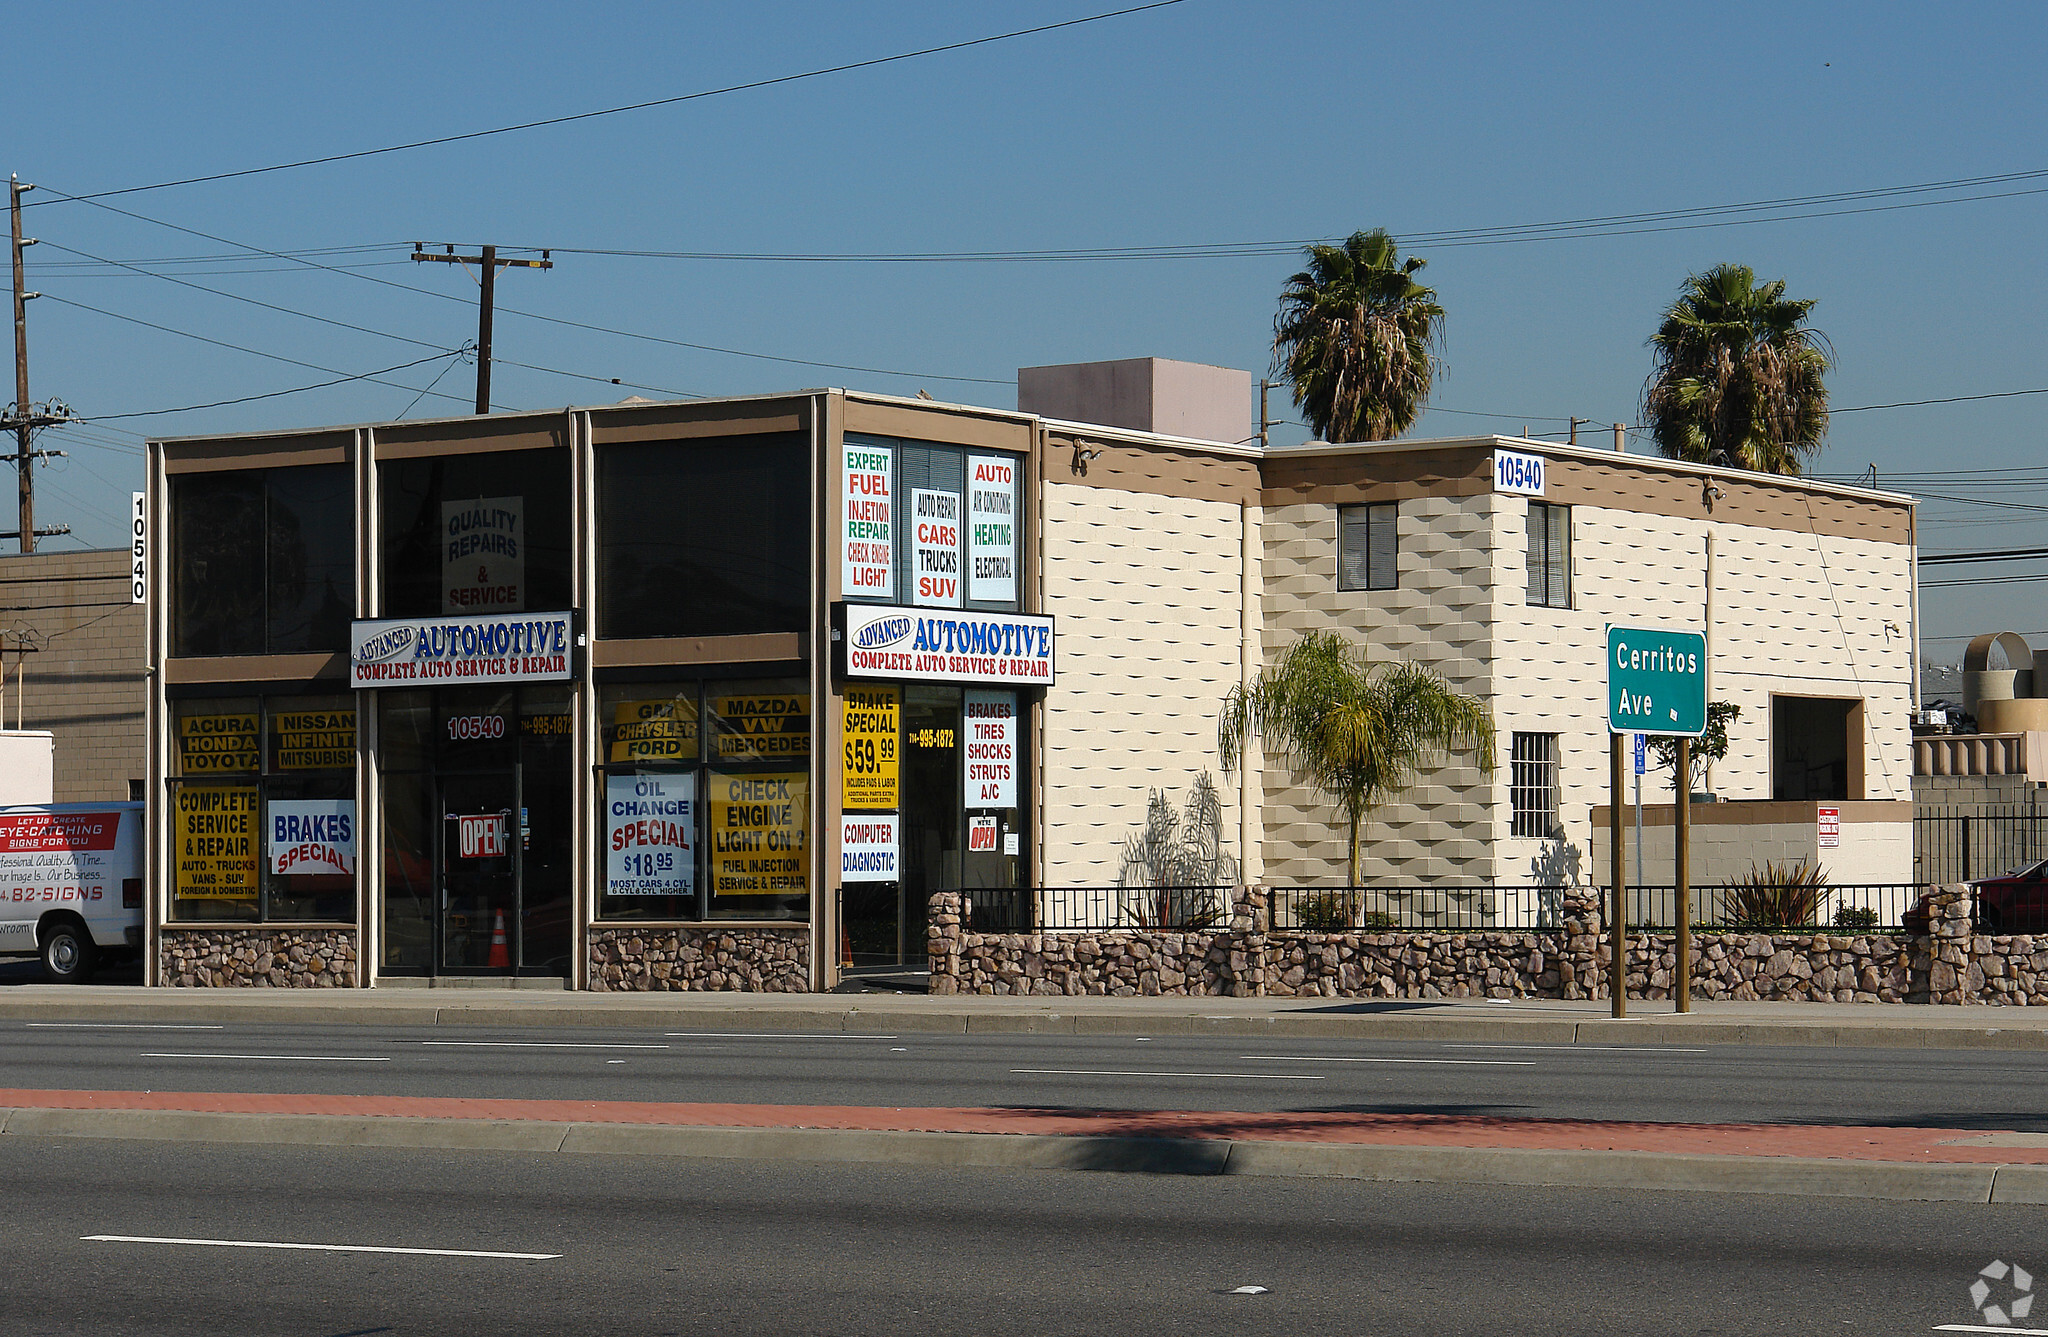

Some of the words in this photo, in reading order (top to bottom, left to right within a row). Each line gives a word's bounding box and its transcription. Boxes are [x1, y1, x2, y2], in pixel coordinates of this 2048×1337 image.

[847, 452, 888, 472] EXPERT
[975, 464, 1011, 484] AUTO
[1498, 456, 1541, 490] 10540
[849, 474, 889, 496] FUEL
[917, 493, 936, 518] AUTO
[937, 495, 957, 521] REPAIR
[973, 490, 983, 511] AIR
[848, 500, 889, 523] INJETION
[448, 509, 517, 536] QUALITY
[848, 521, 889, 540] REPAIR
[918, 523, 956, 547] CARS
[975, 523, 1011, 546] HEATING
[449, 533, 517, 562] REPAIRS
[848, 542, 869, 563] CHECK
[871, 544, 889, 565] ENGINE
[919, 549, 957, 573] TRUCKS
[975, 557, 1012, 579] ELECTRICAL
[477, 565, 488, 583] &
[853, 567, 887, 587] LIGHT
[450, 586, 517, 606] SERVICE
[919, 577, 956, 598] SUV
[360, 629, 412, 661] ADVANCED
[414, 620, 567, 658] AUTOMOTIVE
[858, 617, 911, 647] ADVANCED
[912, 617, 1050, 658] AUTOMOTIVE
[356, 661, 417, 680] COMPLETE
[420, 661, 452, 678] AUTO
[455, 658, 506, 677] SERVICE
[509, 656, 518, 674] &
[522, 655, 567, 674] REPAIR
[852, 650, 912, 671] COMPLETE
[915, 654, 946, 672] AUTO
[949, 656, 996, 675] SERVICE
[999, 659, 1007, 675] &
[1010, 659, 1049, 677] REPAIR
[1617, 642, 1697, 674] Cerritos
[728, 699, 801, 715] MAZDA
[849, 693, 893, 710] BRAKE
[969, 703, 1011, 719] BRAKES
[1618, 688, 1653, 716] Ave
[188, 718, 256, 734] ACURA
[284, 714, 356, 730] NISSAN
[448, 716, 504, 740] 10540
[617, 721, 698, 740] CHRYSLER
[741, 717, 785, 733] VW
[845, 713, 896, 733] SPECIAL
[974, 724, 1004, 740] TIRES
[187, 736, 257, 752] HONDA
[628, 740, 681, 757] FORD
[722, 736, 810, 753] MERCEDES
[968, 743, 1011, 760] SHOCKS
[184, 753, 259, 769] TOYOTA
[969, 764, 1011, 780] STRUTS
[635, 781, 666, 797] OIL
[729, 779, 790, 802] CHECK
[981, 783, 1000, 800] A/C
[180, 792, 257, 812] COMPLETE
[612, 801, 689, 816] CHANGE
[188, 814, 248, 834] SERVICE
[727, 804, 792, 827] ENGINE
[0, 824, 103, 838] EYE-CATCHING
[274, 815, 350, 842] BRAKES
[462, 819, 503, 855] OPEN
[612, 819, 690, 852] SPECIAL
[844, 824, 892, 844] COMPUTER
[971, 827, 995, 849] OPEN
[9, 839, 39, 848] SIGNS
[42, 838, 63, 846] FOR
[65, 837, 89, 845] YOU
[185, 840, 194, 856] &
[197, 837, 249, 856] REPAIR
[716, 831, 763, 853] LIGHT
[767, 830, 791, 852] ON
[797, 829, 805, 851] ?
[181, 861, 207, 871] AUTO
[216, 860, 255, 871] TRUCKS
[277, 843, 349, 874] SPECIAL
[723, 860, 746, 873] FUEL
[749, 859, 799, 873] INJECTION
[843, 852, 895, 872] DIAGNOSTIC
[10, 870, 32, 884] Image
[47, 869, 62, 881] Our
[191, 874, 217, 884] VANS
[226, 873, 244, 884] SUV
[610, 880, 636, 888] MOST
[639, 880, 662, 888] CARS
[665, 880, 670, 888] 4
[673, 880, 691, 888] CYL.
[719, 877, 757, 890] SERVICE
[762, 877, 768, 890] &
[770, 876, 806, 890] REPAIR
[13, 885, 103, 901] 82-SIGNS
[181, 886, 211, 895] FOREIGN
[212, 886, 217, 895] &
[219, 886, 256, 895] DOMESTIC
